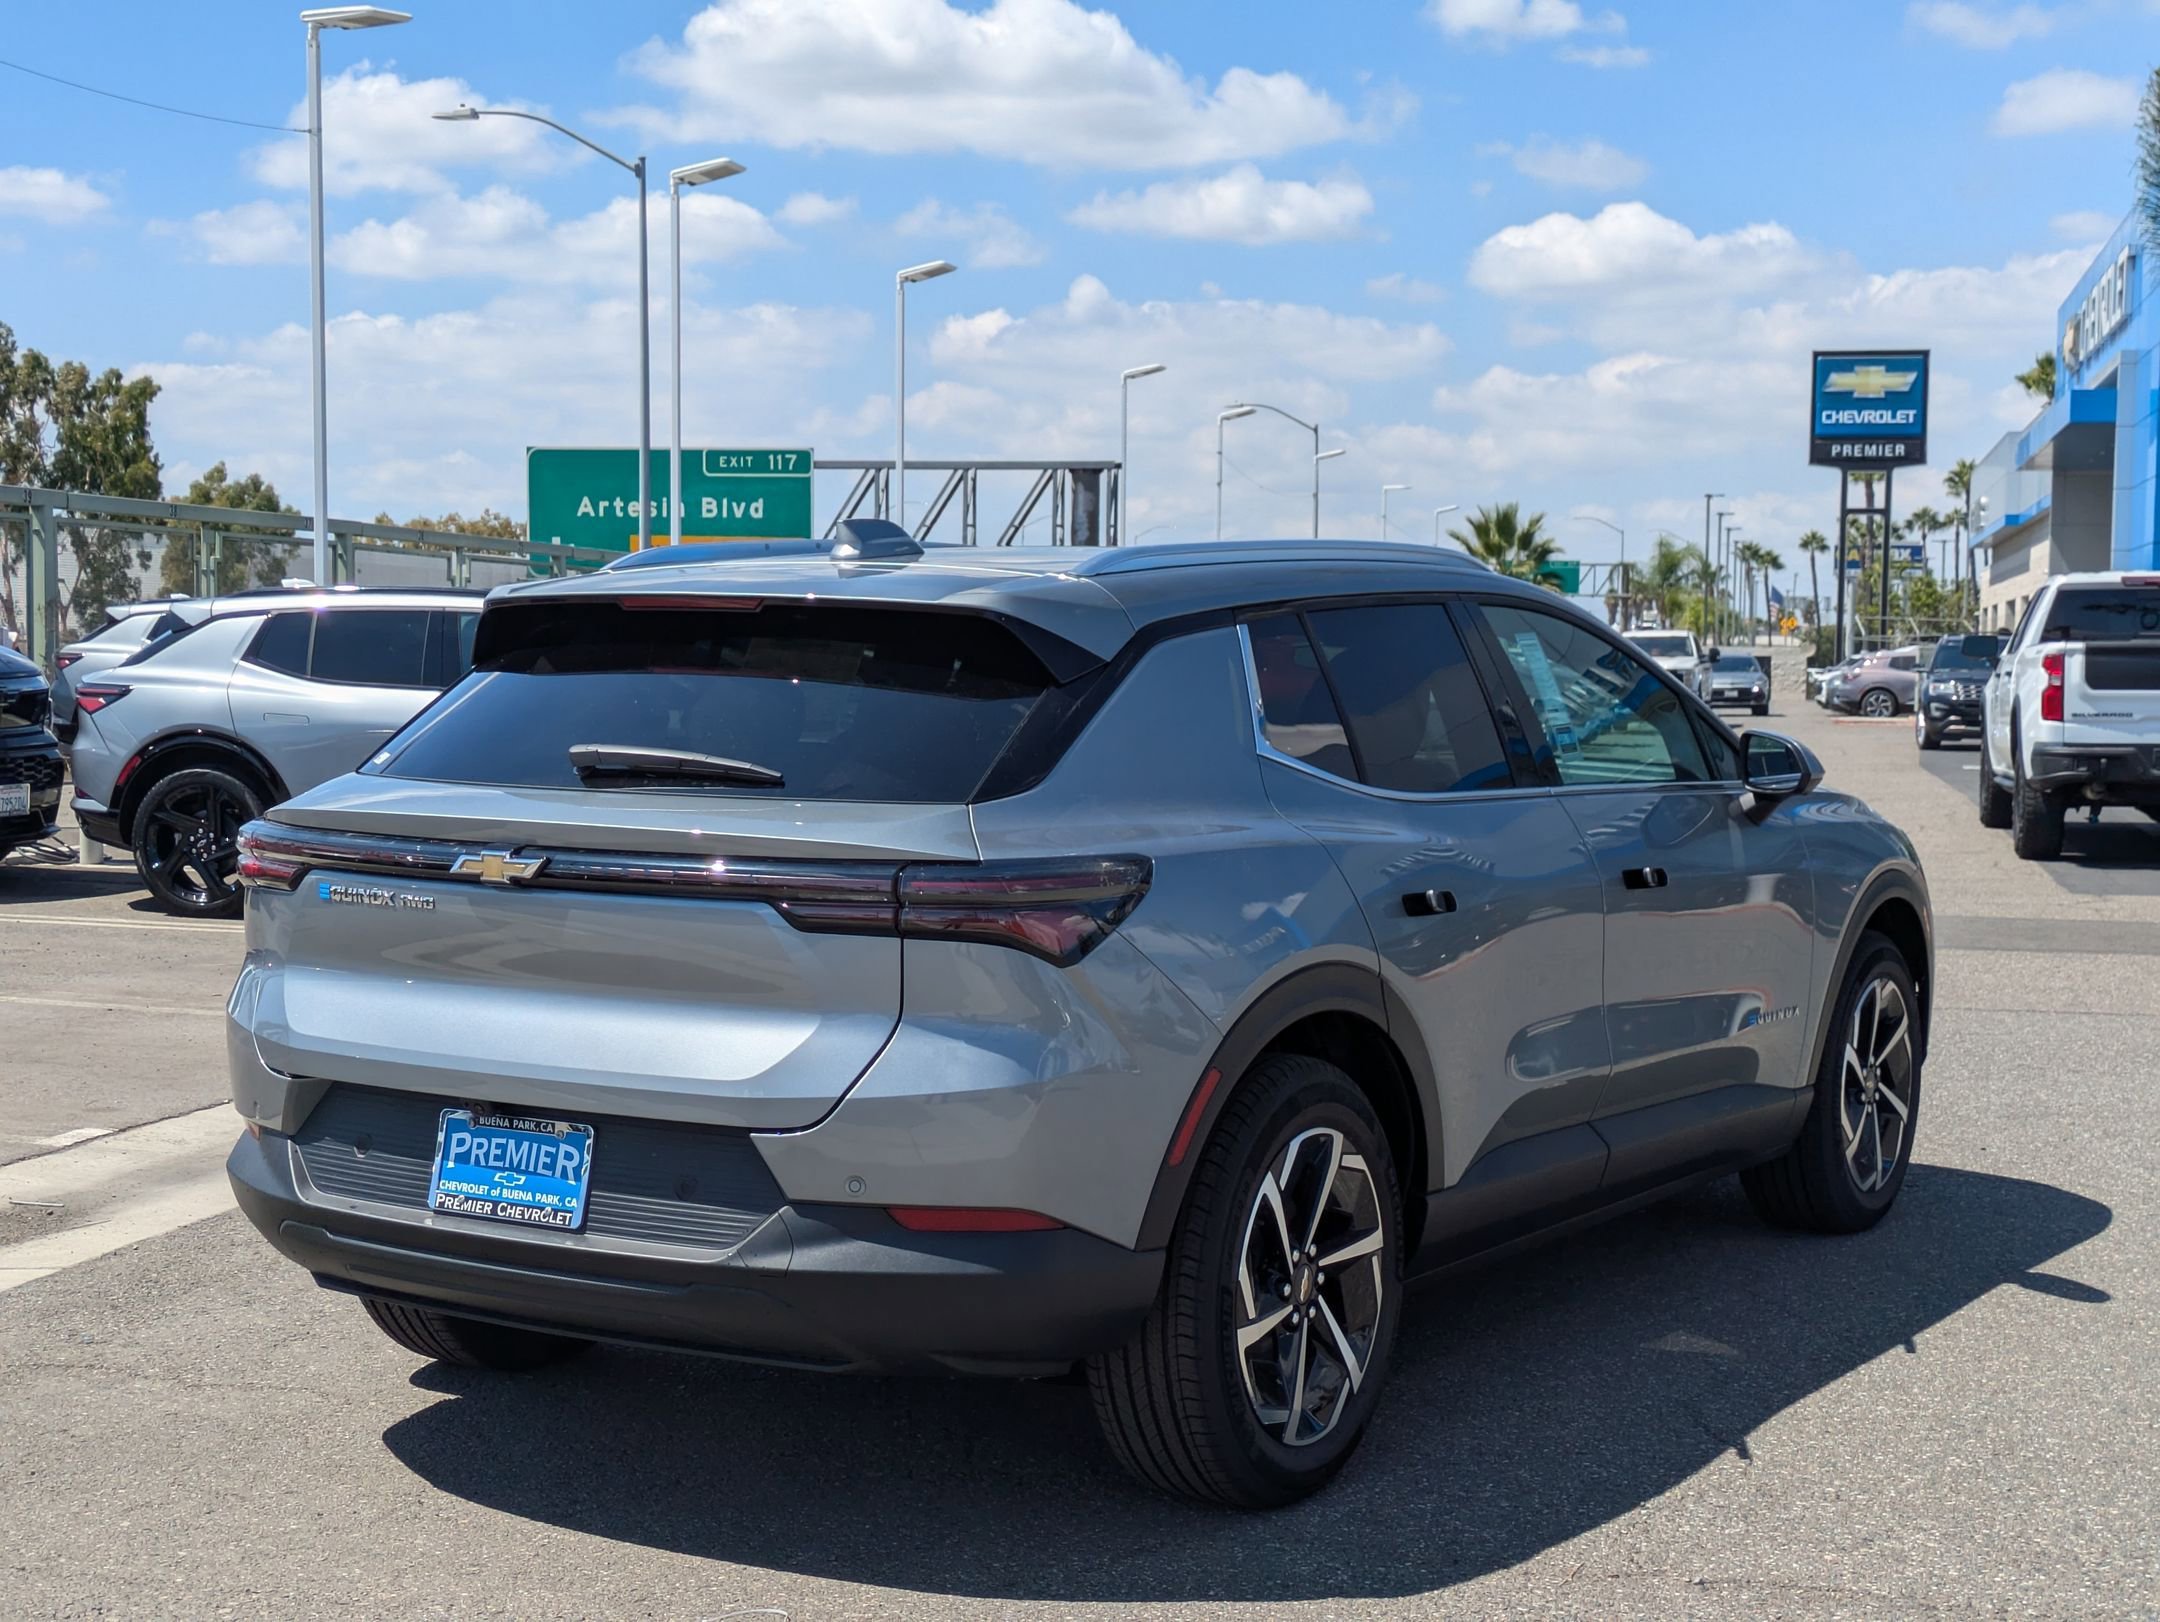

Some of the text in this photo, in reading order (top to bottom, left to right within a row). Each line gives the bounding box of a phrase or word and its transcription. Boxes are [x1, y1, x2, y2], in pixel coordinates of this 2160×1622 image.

[1821, 409, 1917, 424] CHEVROLET
[719, 454, 797, 470] EXIT 117
[1831, 444, 1905, 457] PREMIER
[577, 496, 764, 519] Artesi Blvd
[319, 882, 395, 906] EQUINOX
[479, 1116, 510, 1128] BUENA
[446, 1132, 580, 1185] PREMIER
[439, 1180, 577, 1208] CHEVROLET of BUENA PARK, CA
[435, 1193, 573, 1226] PREMIER CHEVROLET
